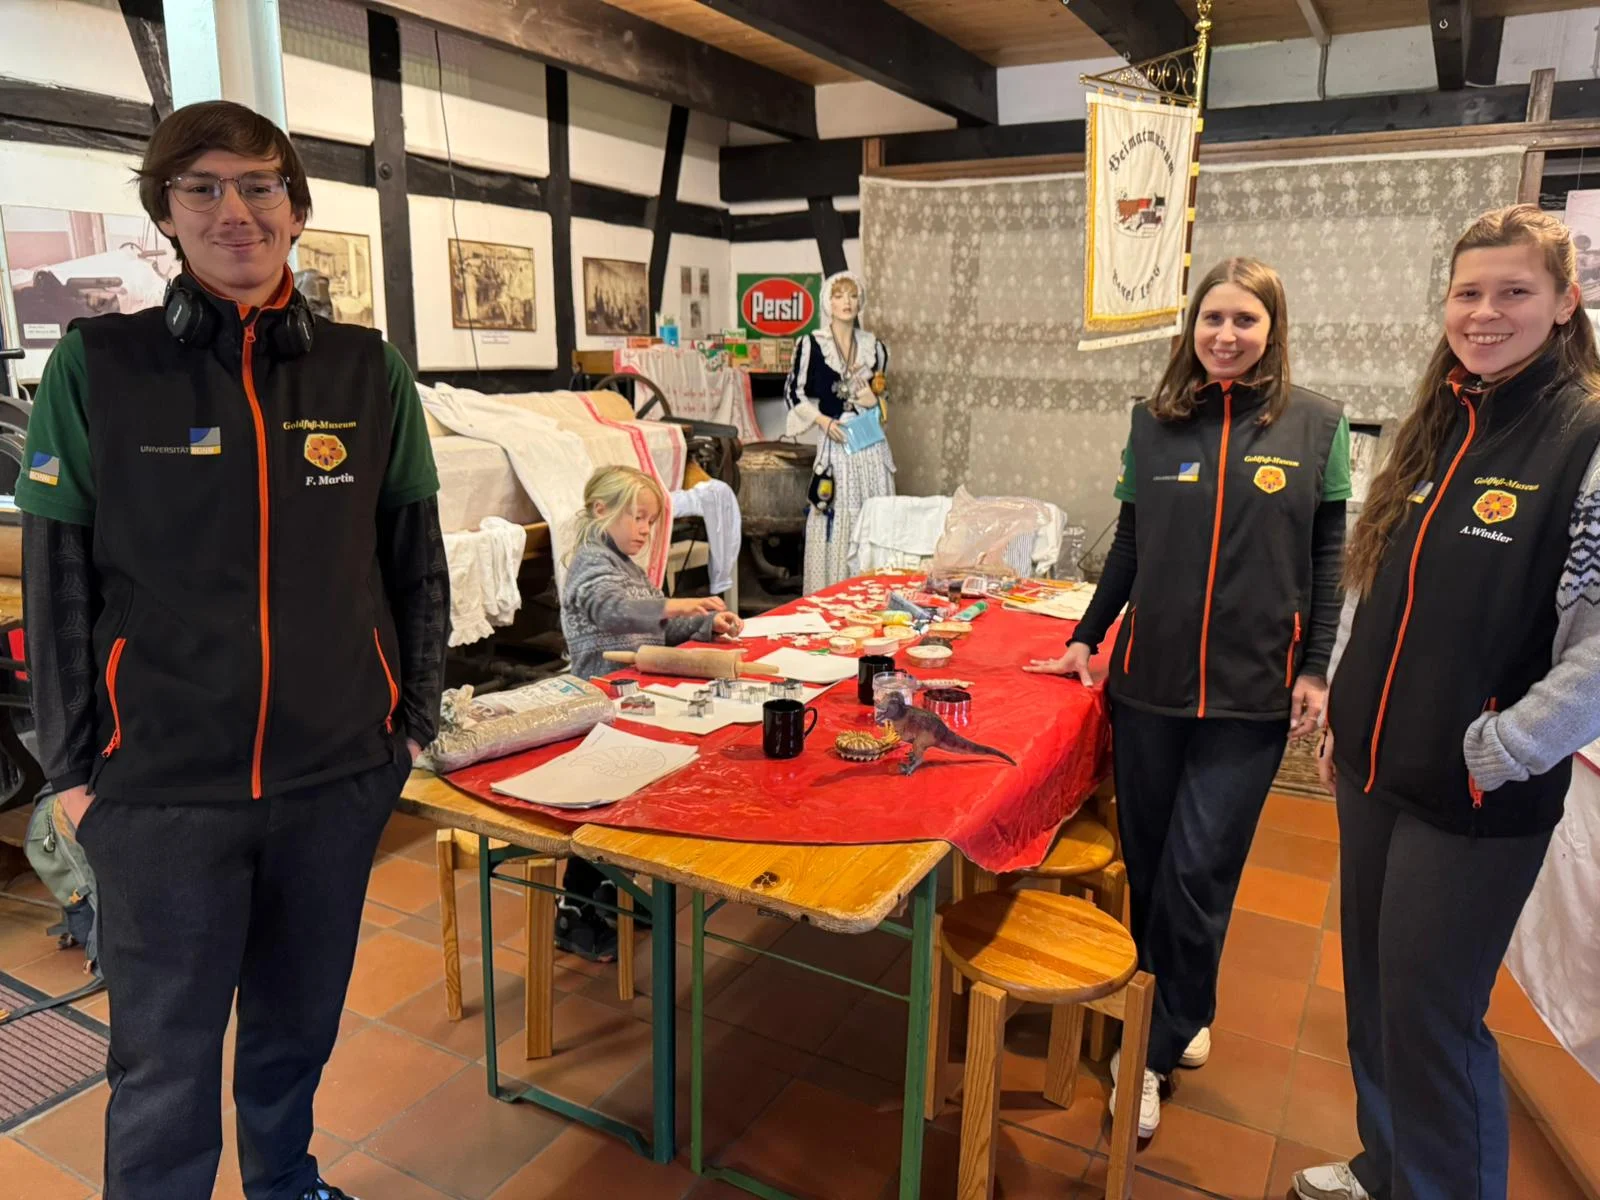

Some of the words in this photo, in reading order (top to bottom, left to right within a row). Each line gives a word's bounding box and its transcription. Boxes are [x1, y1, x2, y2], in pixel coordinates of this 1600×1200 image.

[752, 292, 803, 324] Persil
[305, 476, 316, 486] F.
[318, 472, 354, 486] Martin
